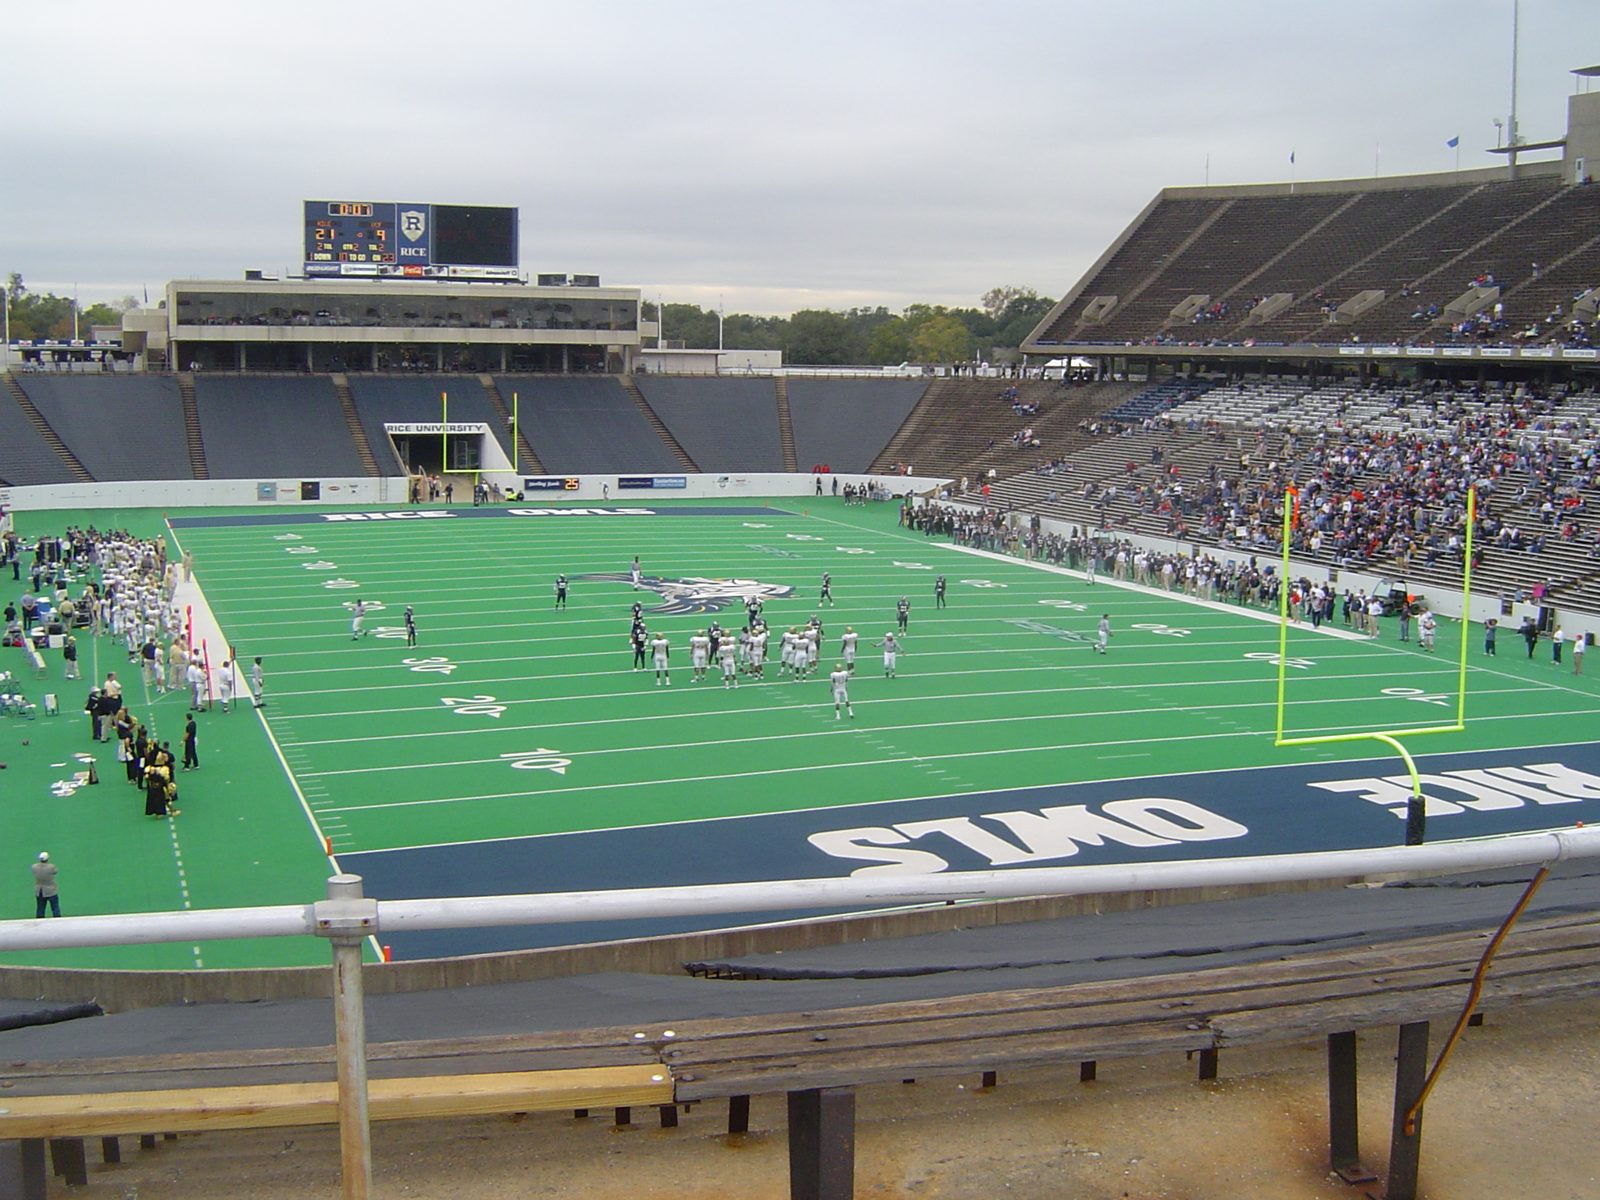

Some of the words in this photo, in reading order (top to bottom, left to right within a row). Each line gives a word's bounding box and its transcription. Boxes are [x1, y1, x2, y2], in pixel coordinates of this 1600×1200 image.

[405, 216, 421, 230] R
[315, 229, 335, 240] 21
[376, 229, 386, 241] 9
[400, 247, 427, 257] RICE
[565, 478, 579, 489] 25
[324, 510, 457, 522] RICE
[507, 508, 656, 516] OWLS
[402, 656, 457, 672] 30
[1380, 687, 1451, 707] 10
[440, 695, 507, 715] 20
[500, 748, 572, 770] 10
[1306, 763, 1600, 819] RICE
[807, 797, 1250, 878] OWLS
